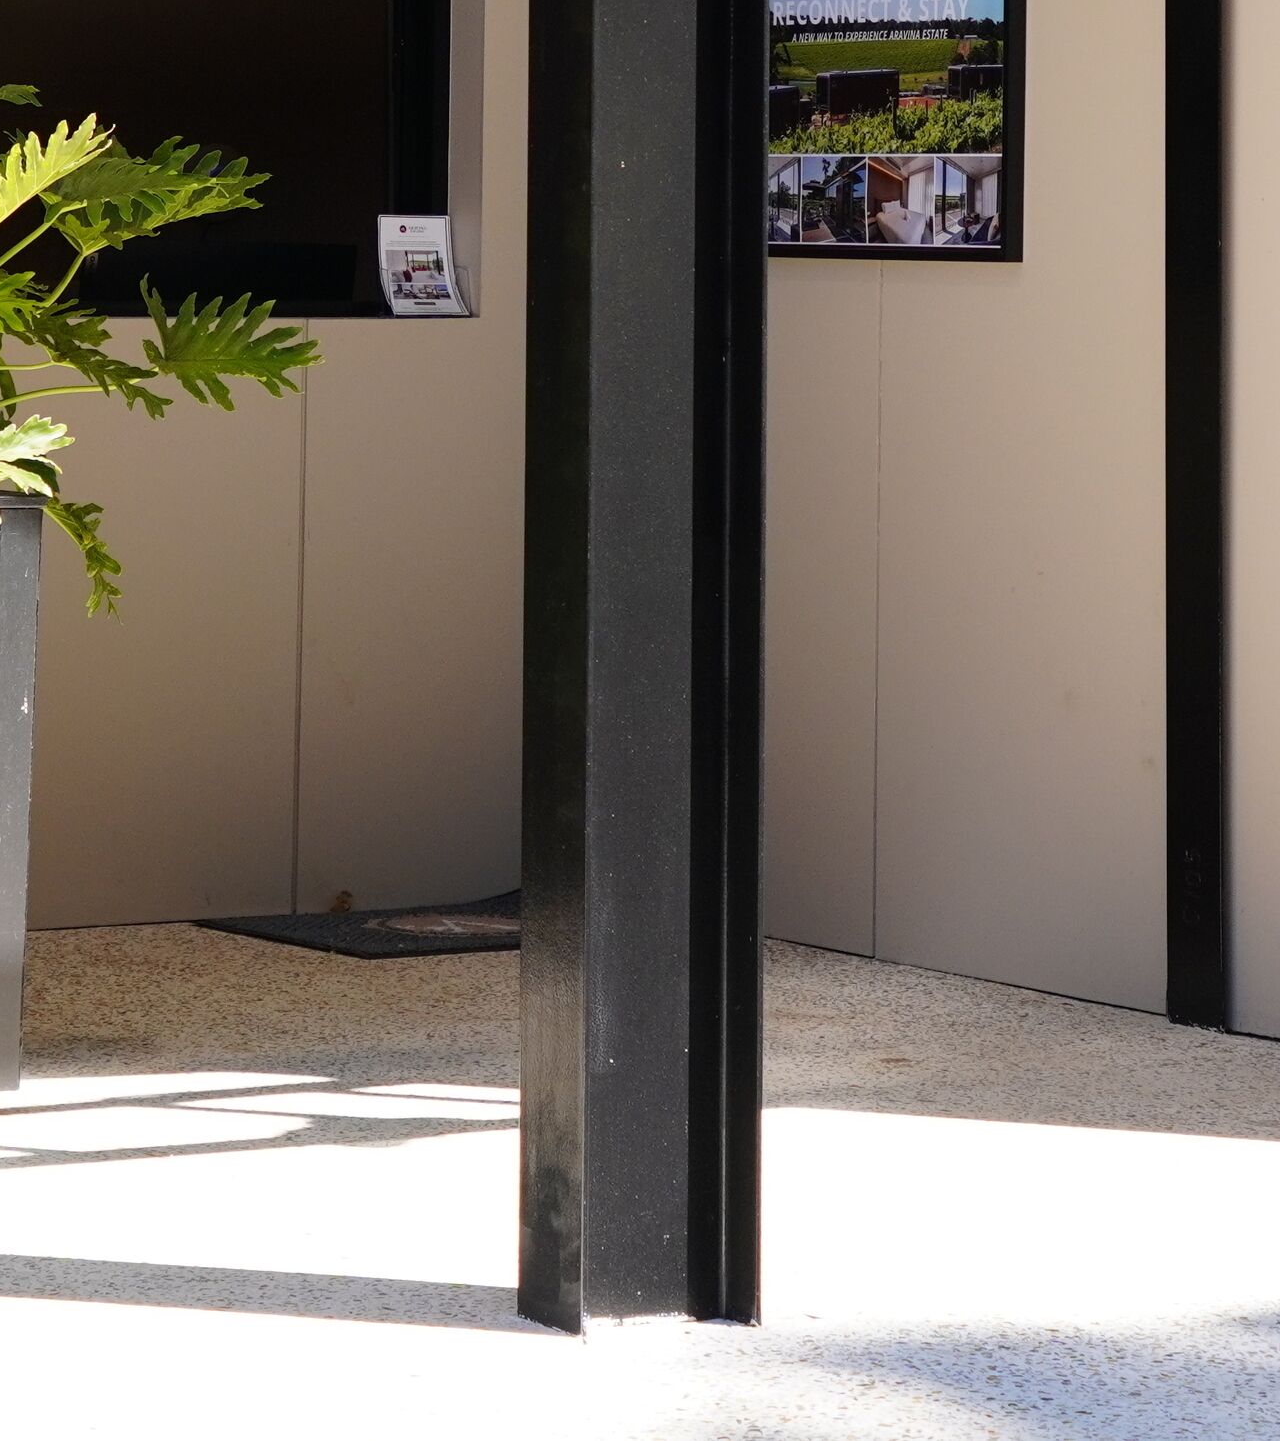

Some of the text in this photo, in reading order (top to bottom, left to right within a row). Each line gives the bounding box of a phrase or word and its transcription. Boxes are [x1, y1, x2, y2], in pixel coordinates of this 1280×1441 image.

[798, 32, 815, 43] NEW
[816, 32, 833, 43] WAY
[834, 31, 844, 41] TO
[845, 30, 888, 41] EXPERIENCE
[889, 30, 921, 41] ARAVINA
[922, 28, 949, 40] ESTATE
